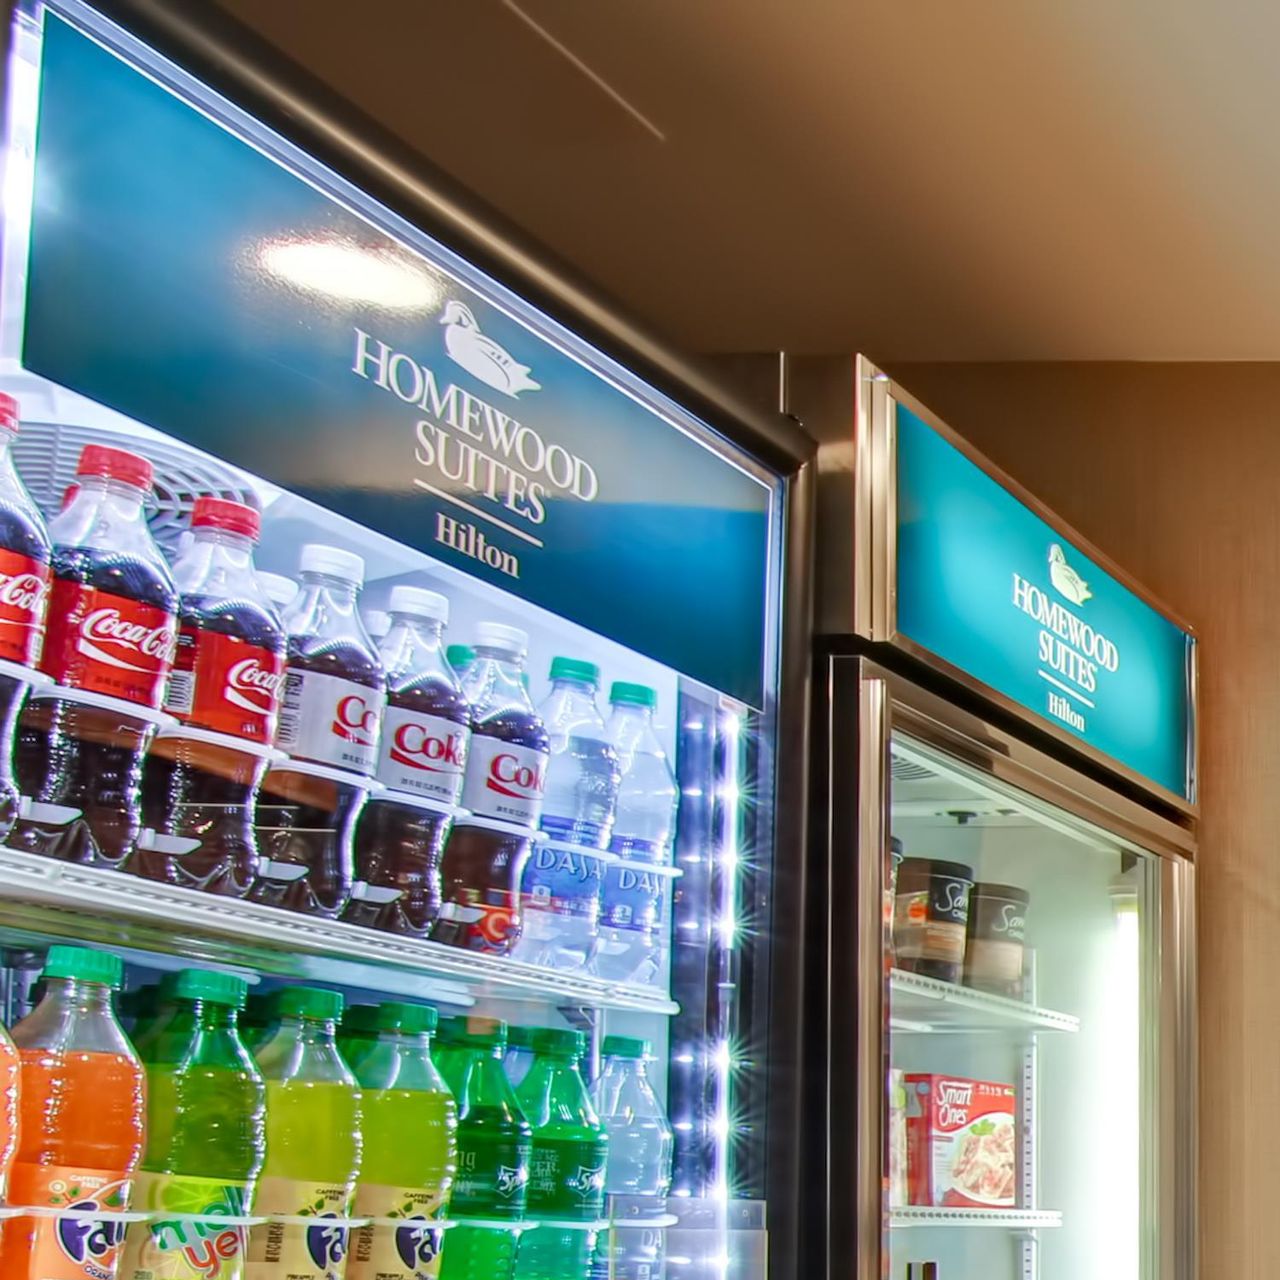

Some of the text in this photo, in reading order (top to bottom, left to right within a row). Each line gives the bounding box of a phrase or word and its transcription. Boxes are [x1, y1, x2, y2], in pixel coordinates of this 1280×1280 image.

[352, 328, 599, 502] HOMEWOOD
[415, 421, 546, 524] SUITES
[434, 512, 519, 578] Hilton
[1013, 573, 1119, 673] HOMEWOOD
[1039, 630, 1097, 693] SUITES
[1048, 691, 1086, 732] Hilton
[934, 1081, 974, 1107] Smart
[938, 1104, 969, 1128] Ones
